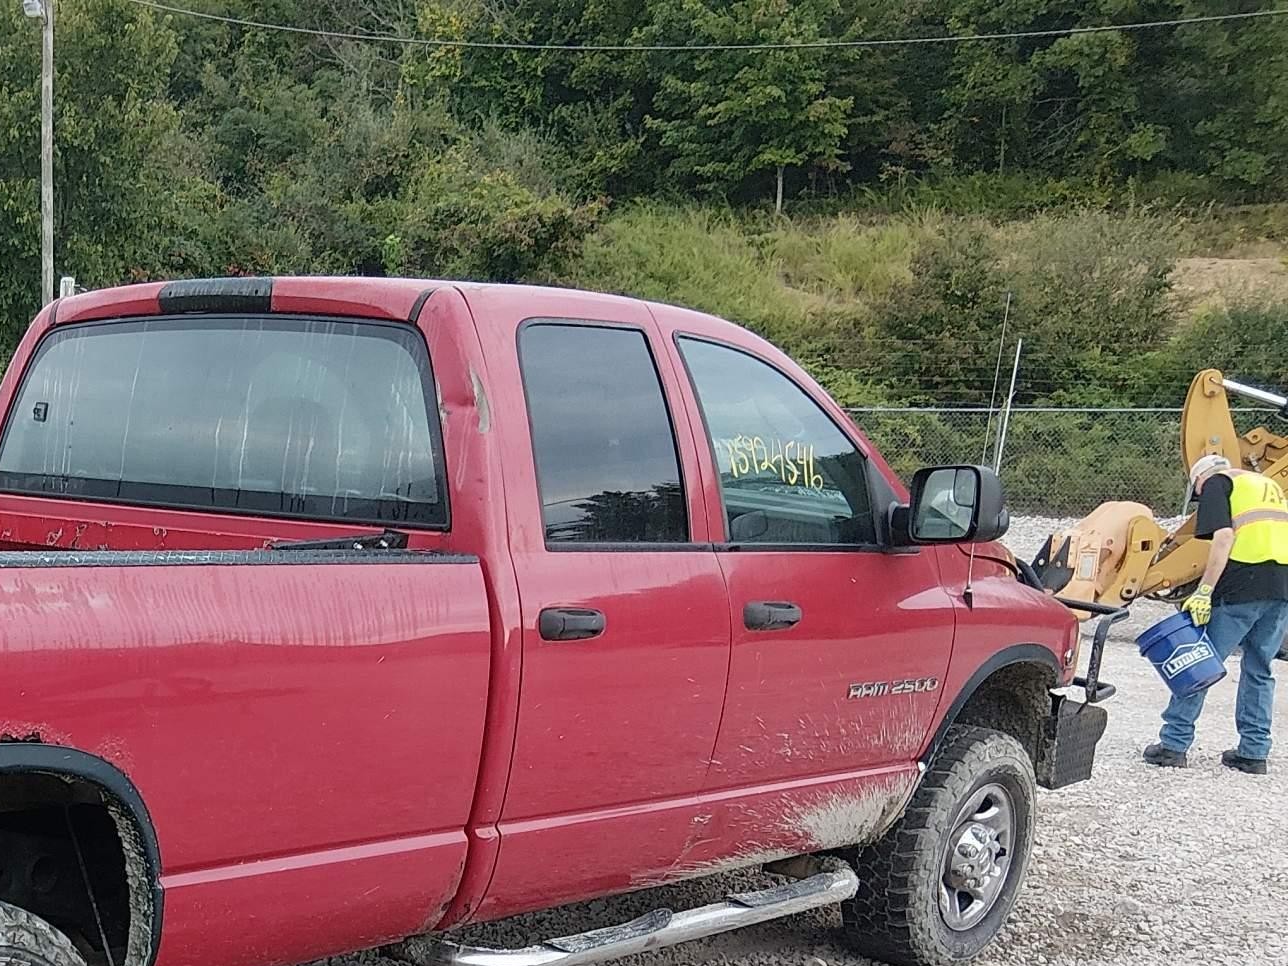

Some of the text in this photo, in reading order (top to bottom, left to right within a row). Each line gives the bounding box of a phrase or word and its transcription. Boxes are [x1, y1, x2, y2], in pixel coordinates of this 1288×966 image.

[712, 433, 824, 490] 5924546
[1165, 645, 1210, 674] LOWE'S
[847, 677, 939, 699] RAM 2500
